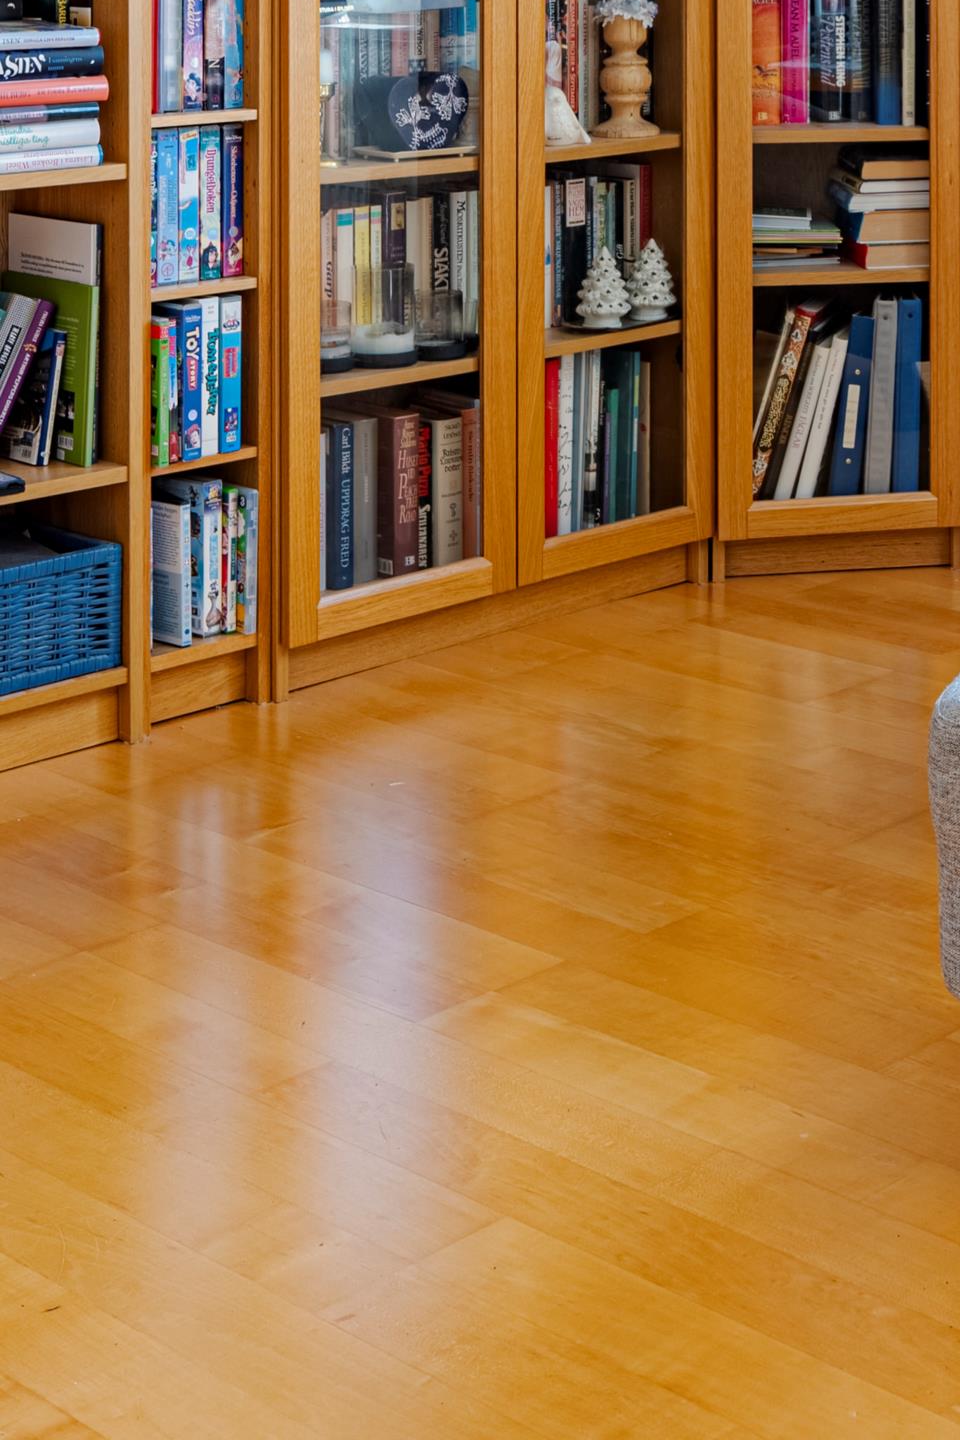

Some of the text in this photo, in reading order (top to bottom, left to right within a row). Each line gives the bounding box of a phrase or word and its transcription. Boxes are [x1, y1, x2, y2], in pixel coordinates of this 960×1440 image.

[790, 36, 800, 58] AUEL
[835, 15, 846, 87] STEPHEN KING
[205, 149, 217, 213] Djungelboken
[324, 260, 333, 298] Garp
[185, 326, 200, 361] TOY
[418, 427, 430, 465] Mario
[339, 428, 350, 568] Carl Bildt UPPDRAG FRED
[418, 467, 431, 497] Puzo
